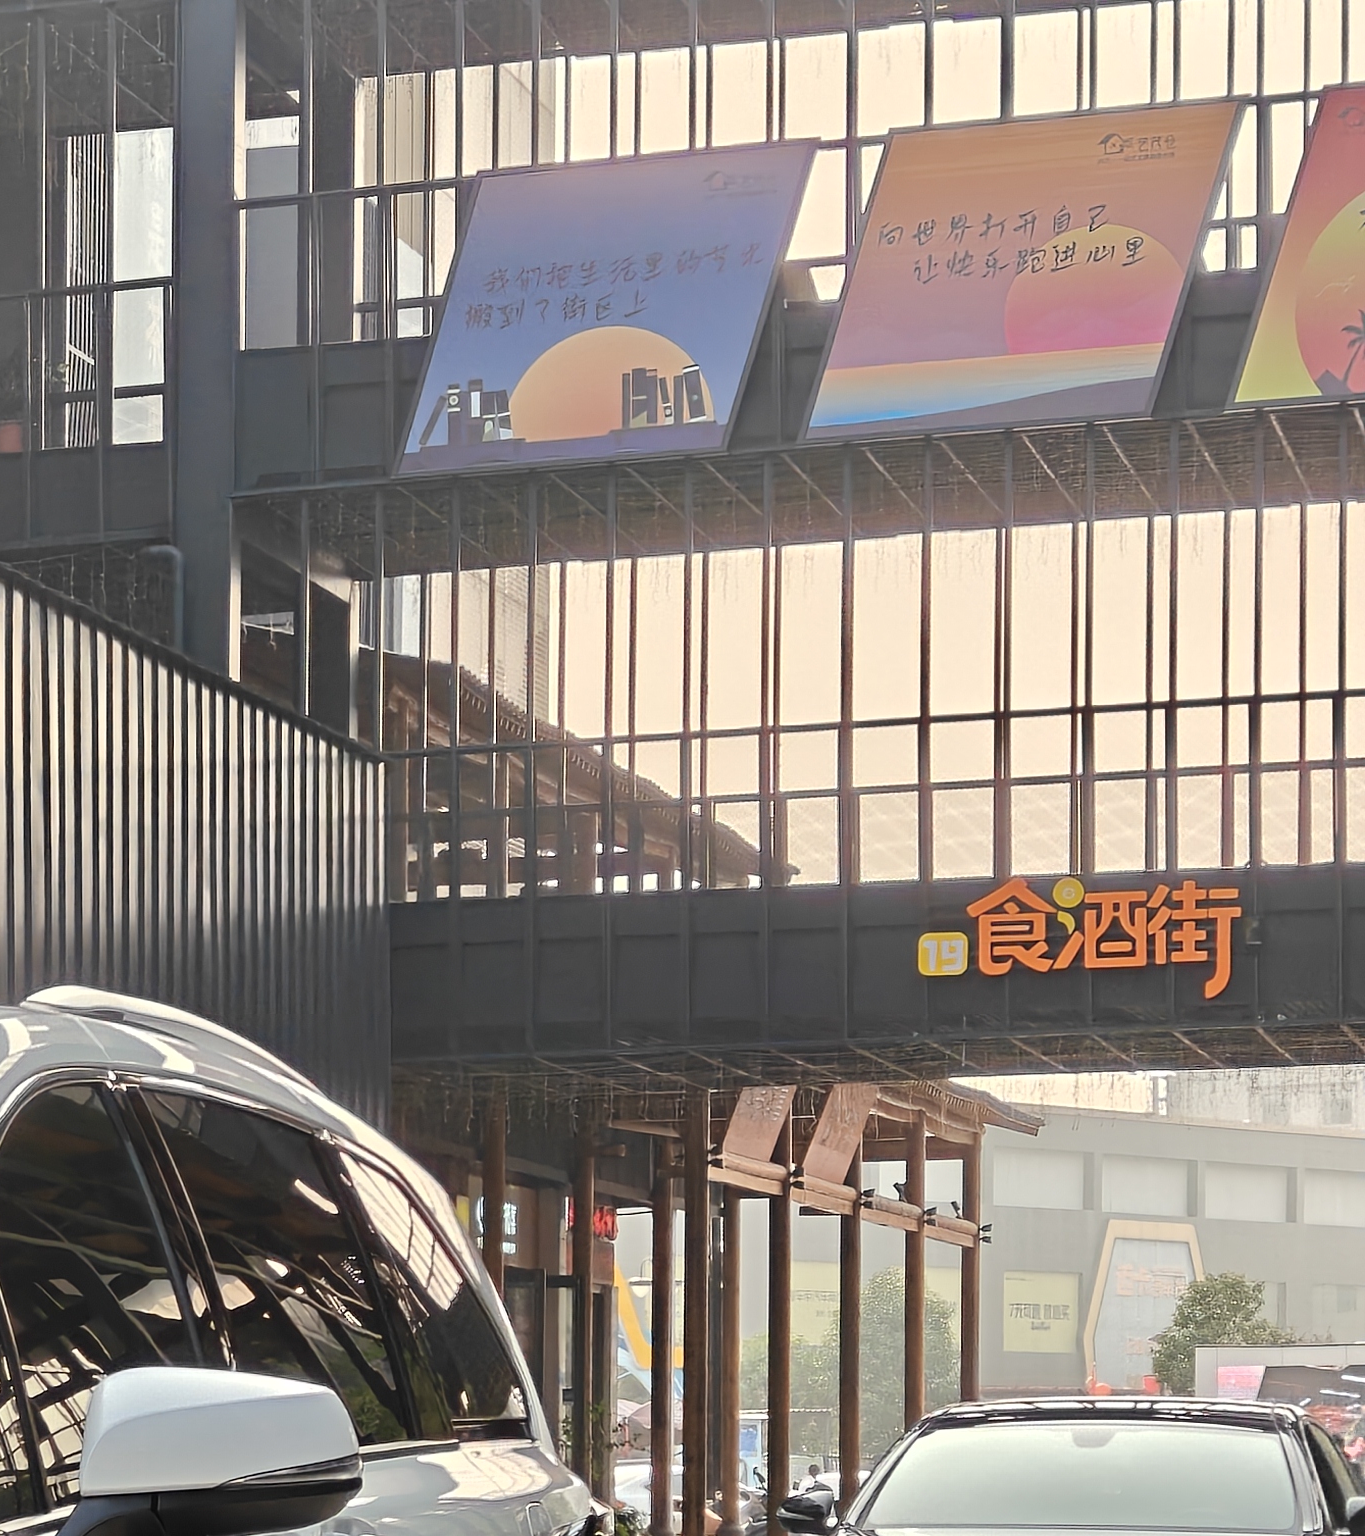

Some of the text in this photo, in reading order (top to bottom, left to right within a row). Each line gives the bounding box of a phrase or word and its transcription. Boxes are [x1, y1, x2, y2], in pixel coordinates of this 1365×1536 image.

[878, 203, 1110, 247] 向世界打开自己
[913, 235, 1148, 285] 让快乐跑进心里
[464, 289, 649, 331] 搬到了街区上
[920, 877, 1242, 999] 19 食酒街
